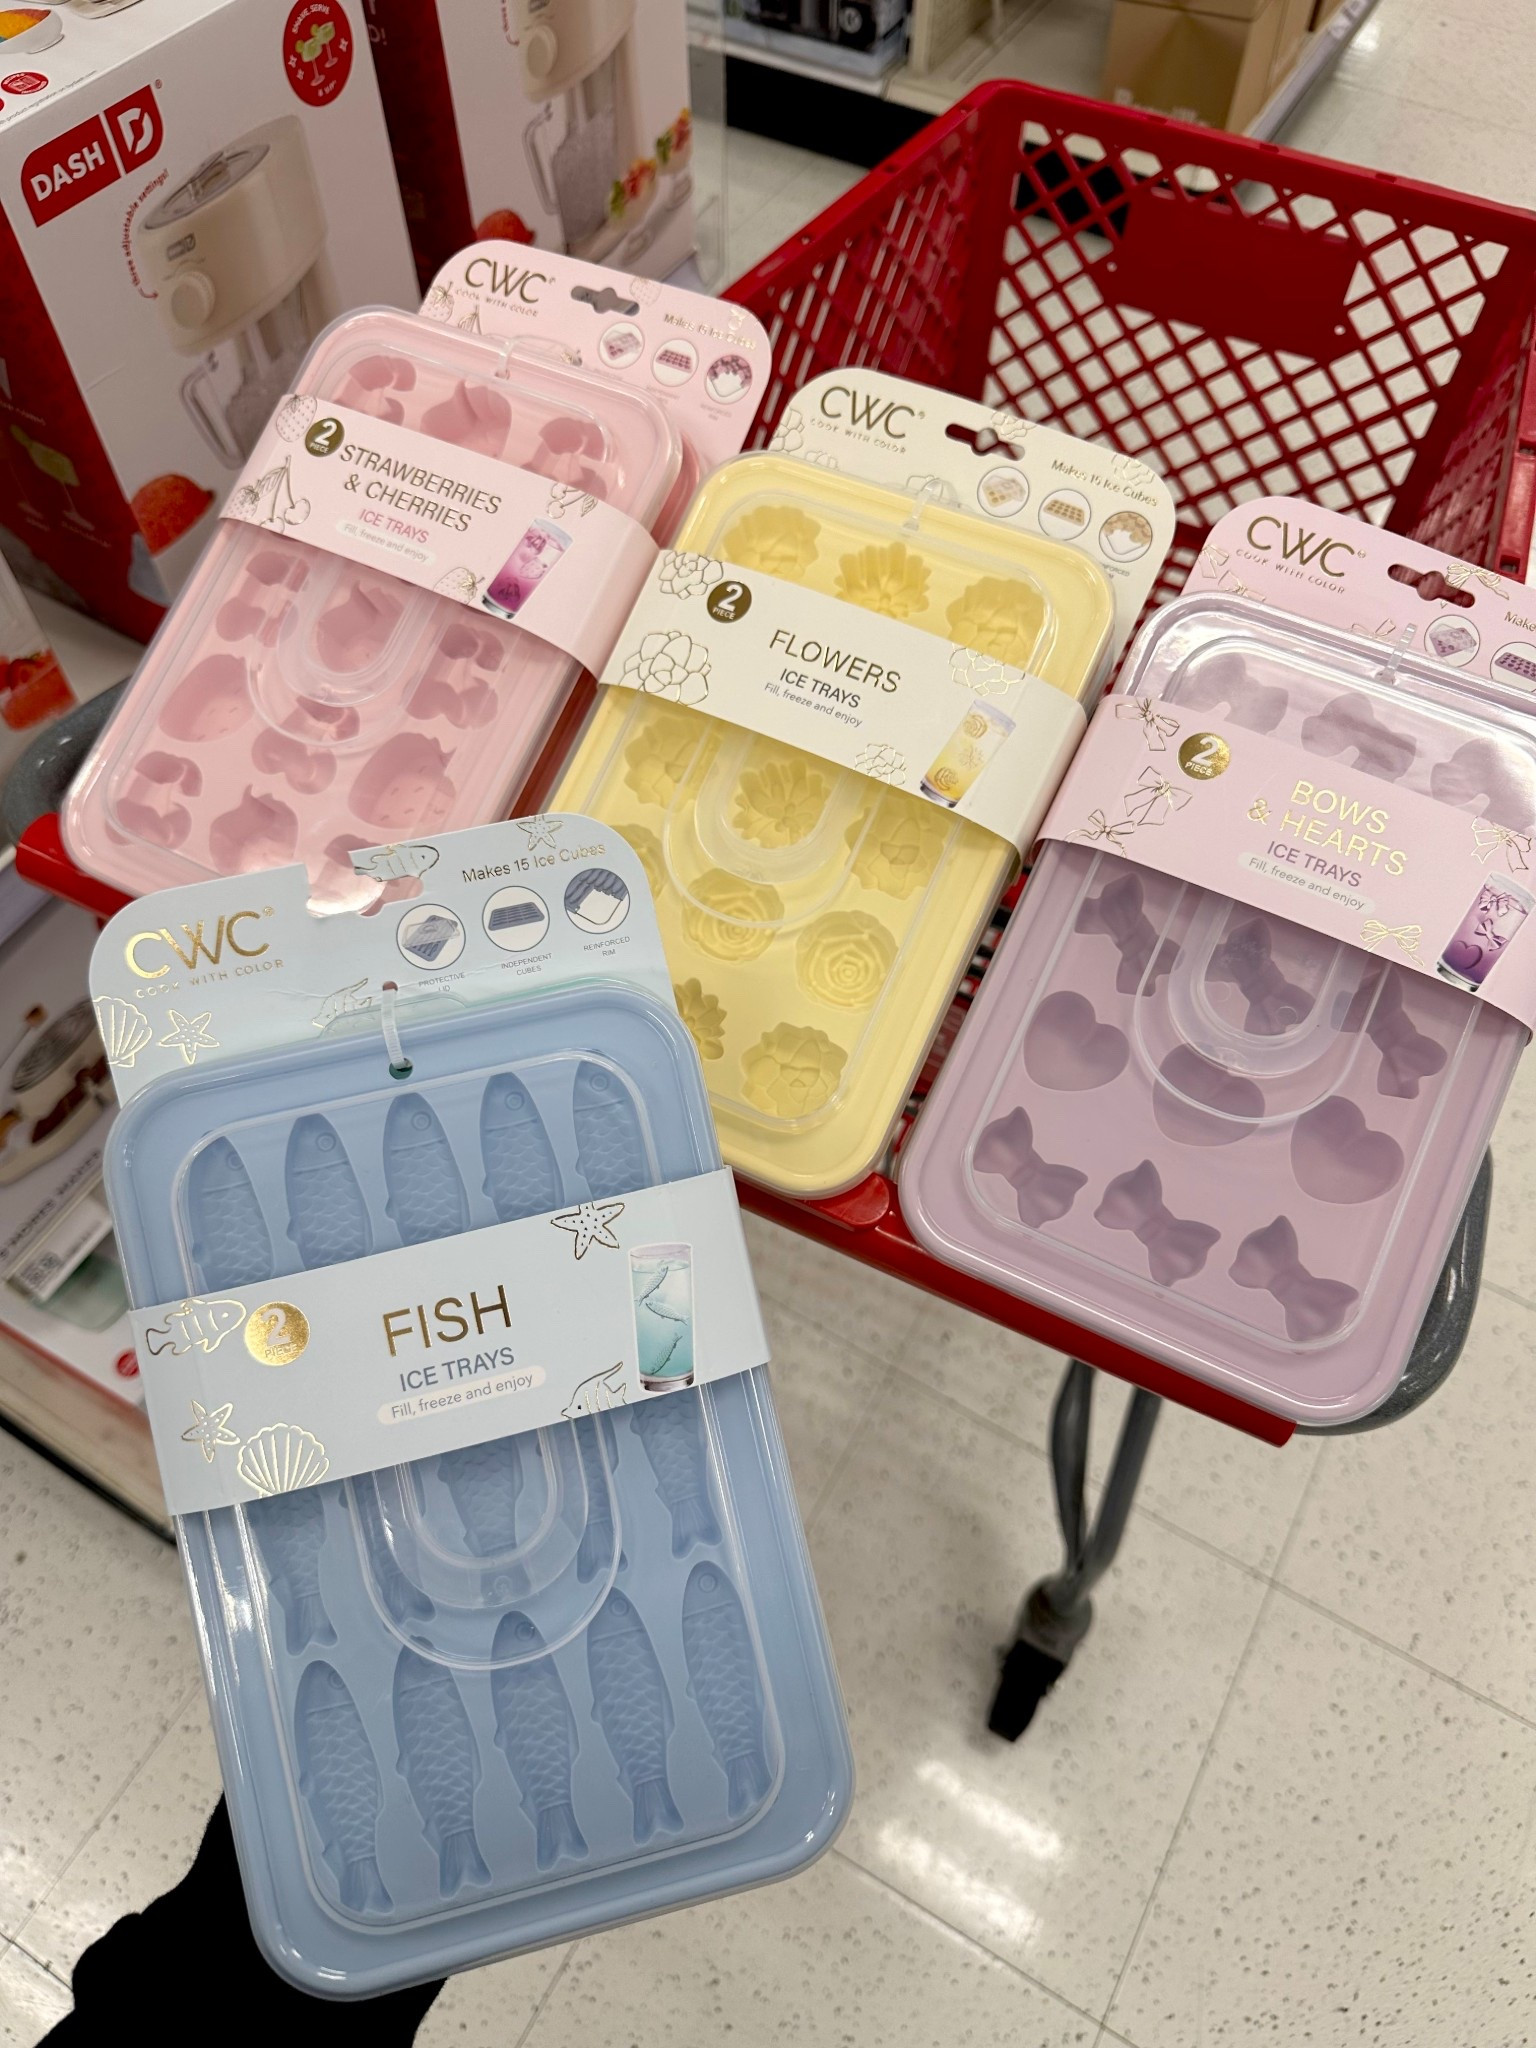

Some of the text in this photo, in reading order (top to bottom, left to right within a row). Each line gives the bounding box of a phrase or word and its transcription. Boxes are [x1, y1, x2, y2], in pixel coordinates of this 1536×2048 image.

[30, 141, 106, 202] DASH
[465, 258, 547, 304] CWC
[486, 297, 508, 309] WITH
[664, 313, 695, 331] Makes
[821, 386, 915, 439] CWC
[309, 442, 329, 454] PIECE
[314, 421, 337, 445] 2
[810, 418, 906, 454] COOK WITH COLOR
[340, 444, 502, 514] STRAWBERRIES
[1051, 459, 1158, 507] Makes 15 Ice Cubes
[344, 473, 472, 532] & CHERRIES
[344, 523, 429, 563] Fill, freeze and enjoy
[359, 509, 429, 543] ICE TRAYS
[1236, 548, 1345, 594] COOK WITH COLOR
[713, 607, 736, 620] PIECE
[718, 583, 743, 612] 2
[769, 629, 901, 693] FLOWERS
[764, 682, 863, 728] Fill, freeze and enjoy
[780, 668, 861, 708] ICE TRAYS
[1185, 761, 1213, 776] PIECE
[1191, 736, 1219, 767] 2
[1291, 780, 1390, 834] BOWS
[1246, 798, 1408, 876] & HEARTS
[462, 844, 606, 883] Makes 15 Ice Cubes
[1267, 841, 1362, 887] ICE TRAYS
[1248, 857, 1365, 911] Fill, freeze and enjoy
[501, 952, 553, 970] INDEPENDENT
[583, 936, 631, 952] REINFORCED
[602, 949, 616, 957] RIM
[136, 959, 285, 999] COOK WITH COLOR
[418, 972, 465, 988] PROTECTIVE
[516, 965, 542, 976] CUBES
[261, 1308, 290, 1346] 2
[382, 1285, 512, 1357] FISH
[265, 1343, 297, 1357] PIECE
[400, 1347, 515, 1392] ICE TRAYS
[391, 1374, 533, 1419] Fill, freeze and enjoy
